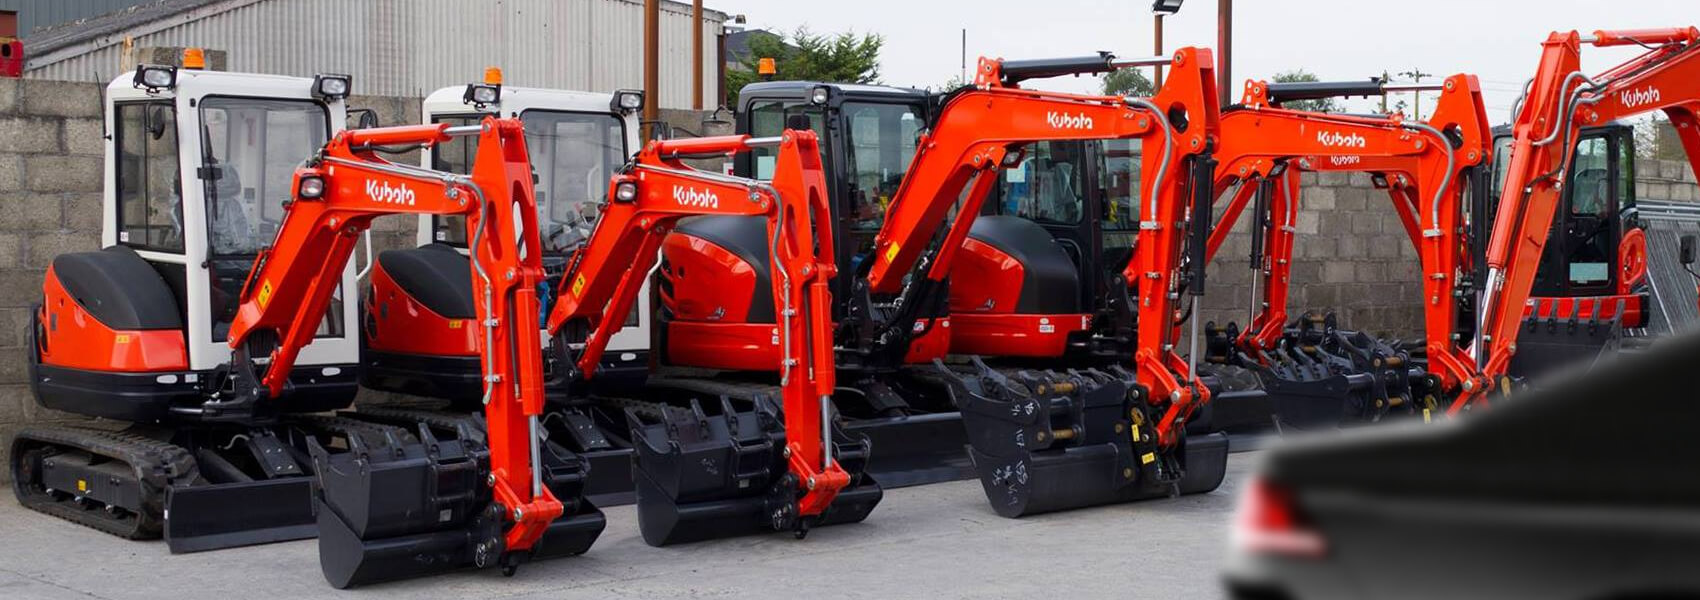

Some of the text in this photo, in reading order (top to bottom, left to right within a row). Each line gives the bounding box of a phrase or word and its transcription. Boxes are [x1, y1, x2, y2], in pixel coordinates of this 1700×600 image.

[1621, 85, 1661, 108] Kubota
[1047, 112, 1093, 129] Kubota
[1317, 131, 1365, 148] Kubota
[1331, 154, 1360, 166] Kubota
[366, 179, 415, 206] Kubota
[673, 185, 718, 208] Kubota
